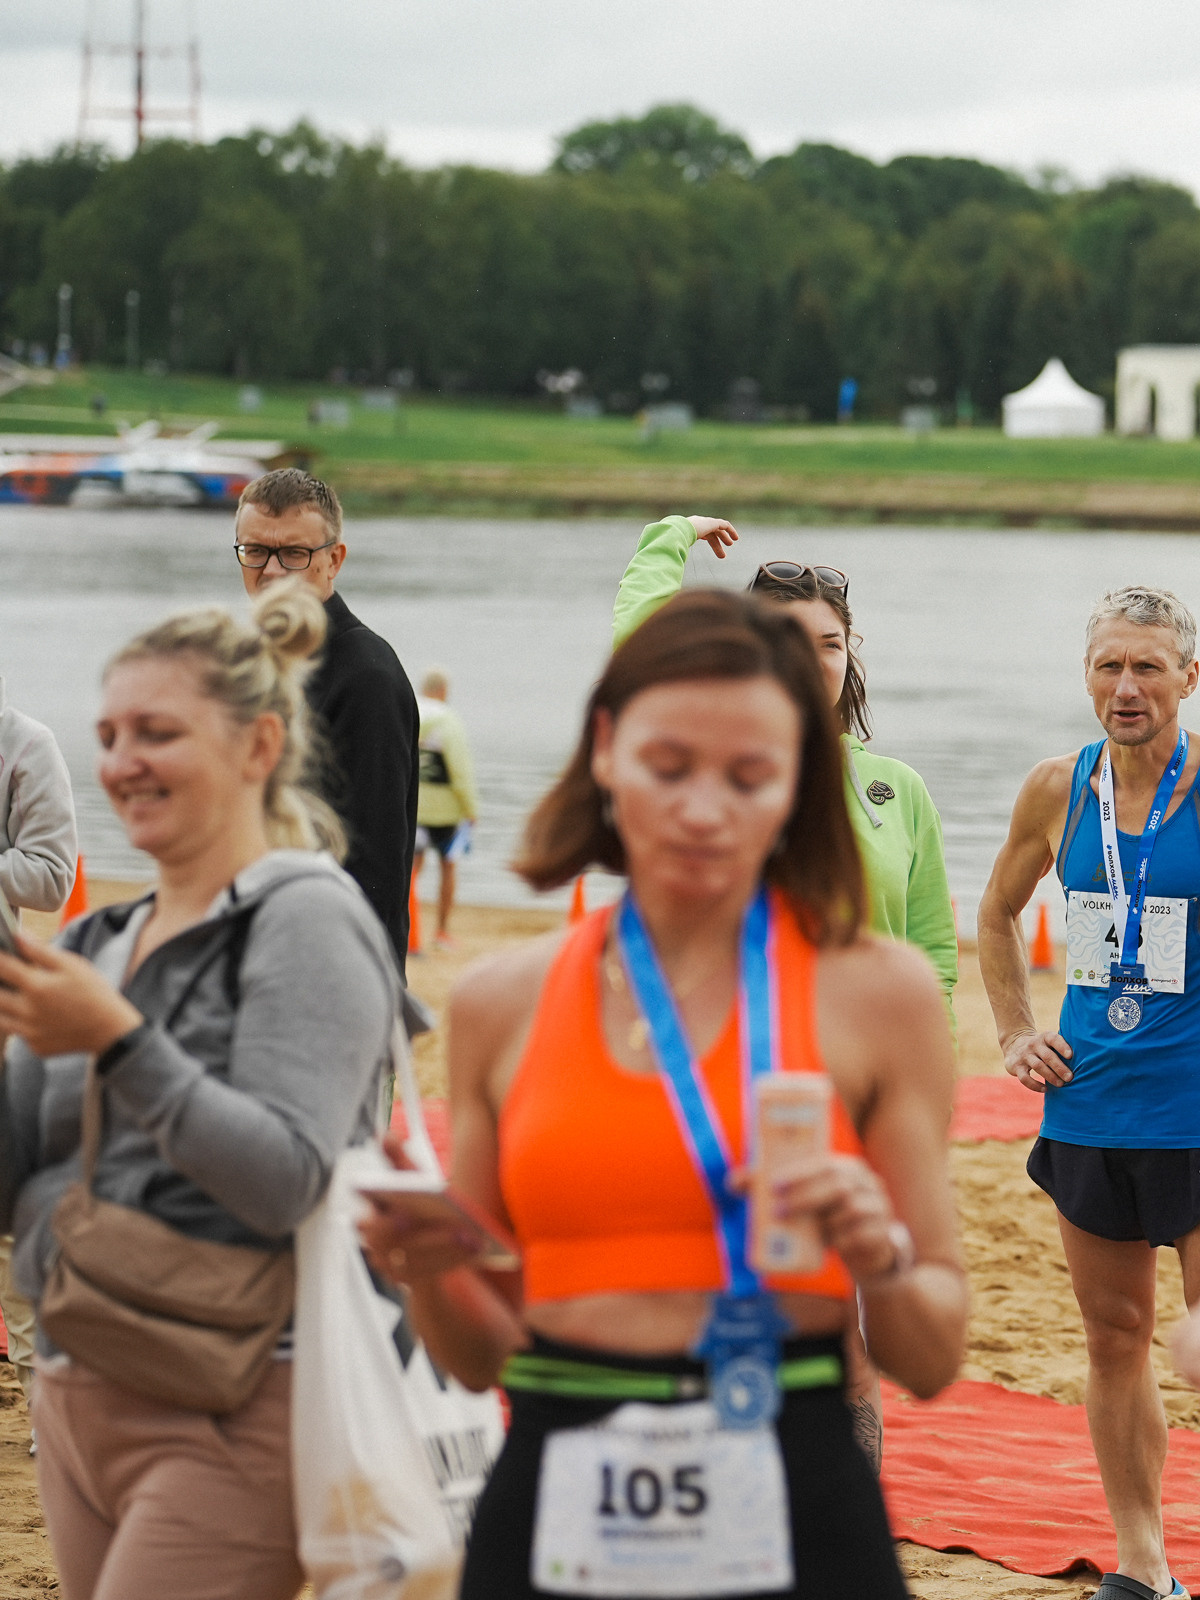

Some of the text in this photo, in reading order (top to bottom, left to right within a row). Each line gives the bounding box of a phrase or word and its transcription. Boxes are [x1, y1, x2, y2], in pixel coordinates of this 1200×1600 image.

[1102, 801, 1110, 822] 2023
[1148, 810, 1161, 830] 2023
[1149, 905, 1171, 915] 2023
[598, 1464, 709, 1519] 105
